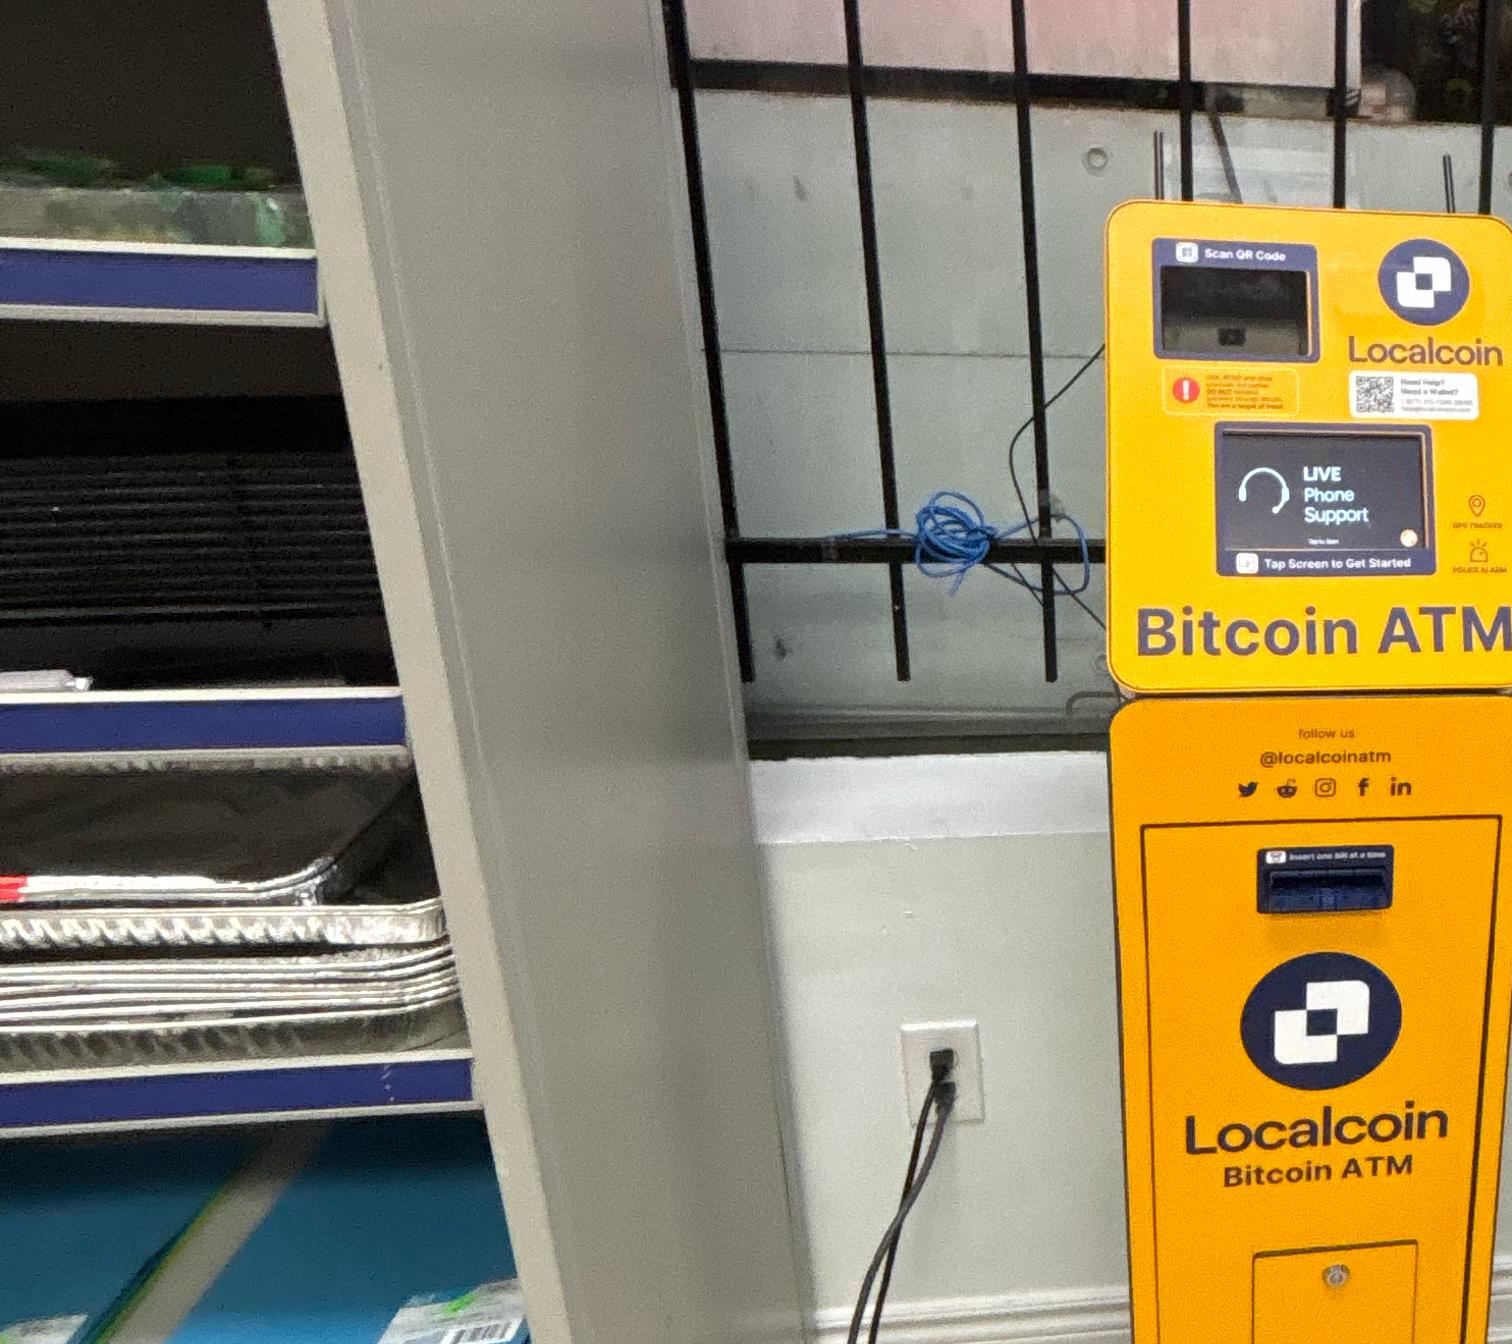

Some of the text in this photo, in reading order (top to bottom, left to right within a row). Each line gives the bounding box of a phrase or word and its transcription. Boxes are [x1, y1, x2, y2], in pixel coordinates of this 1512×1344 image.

[1204, 248, 1287, 261] Scan QR Code
[1348, 335, 1504, 367] Localcoin
[1303, 466, 1341, 482] LIVE
[1304, 488, 1355, 503] Phone
[1304, 507, 1369, 526] Support
[1264, 558, 1412, 571] Tap Screen to Get Started
[1137, 606, 1358, 658] Bitcoin
[1299, 729, 1355, 739] follow us
[1260, 751, 1392, 768] @localcoinatm
[1184, 1100, 1449, 1157] Localcoin
[1223, 1154, 1413, 1188] Bitcoin ATM
